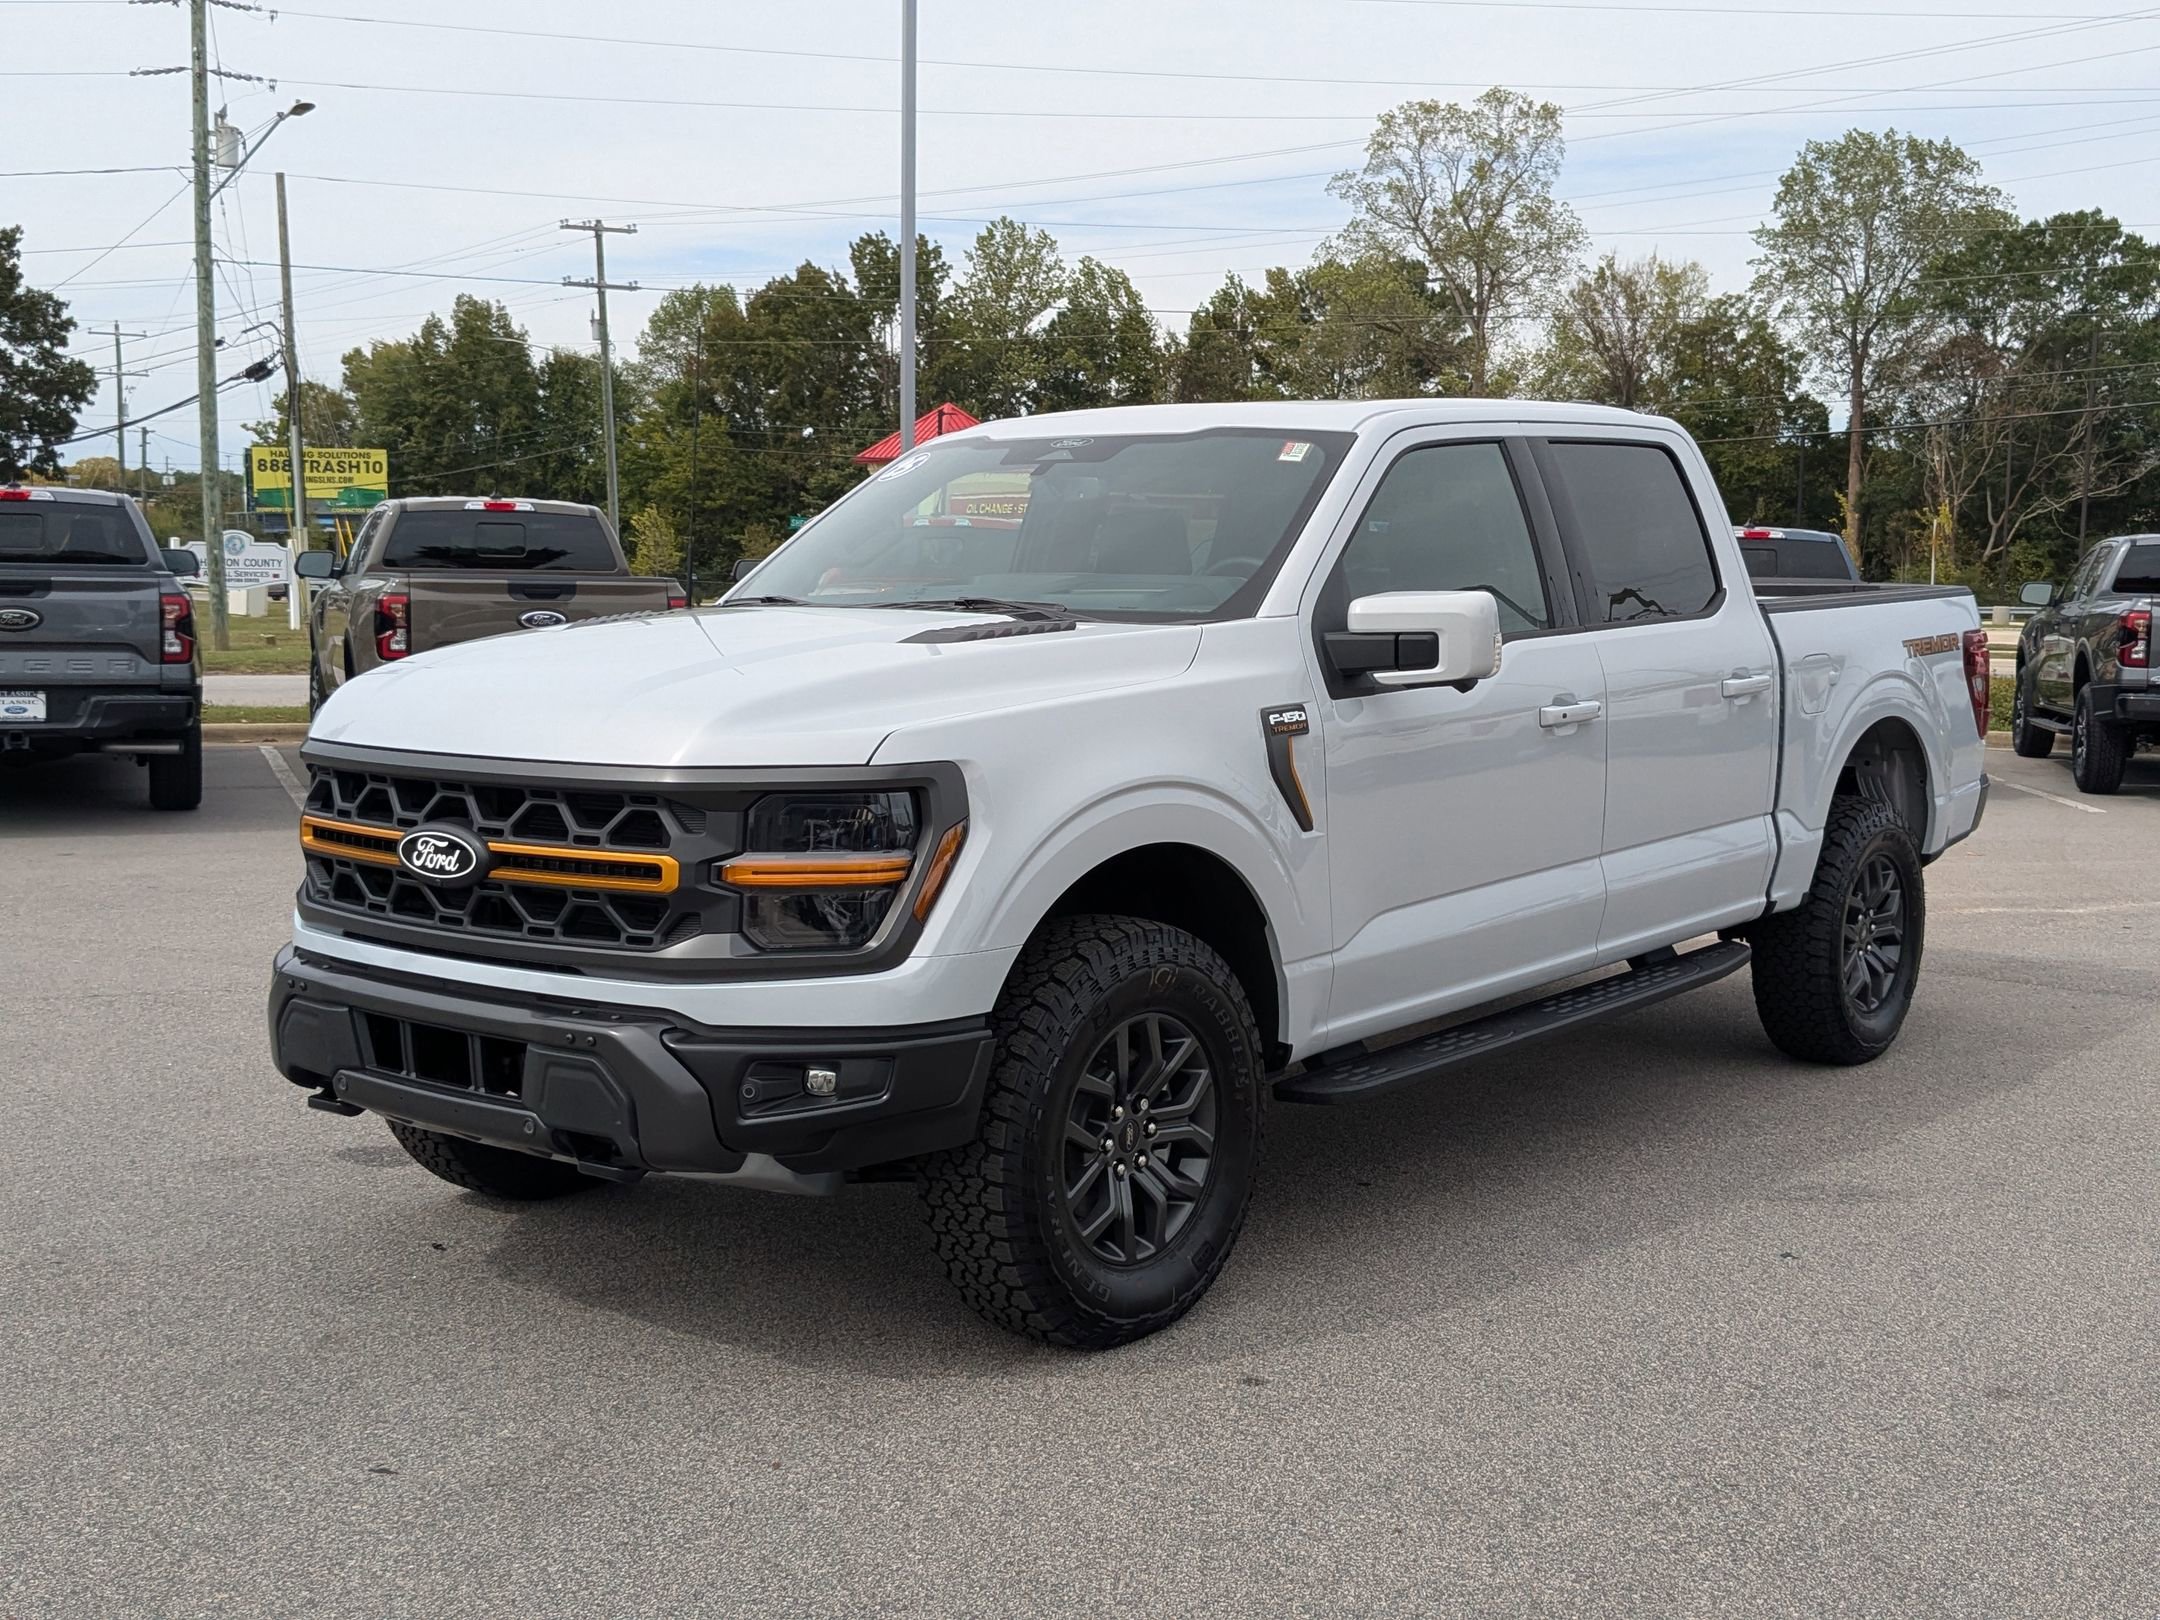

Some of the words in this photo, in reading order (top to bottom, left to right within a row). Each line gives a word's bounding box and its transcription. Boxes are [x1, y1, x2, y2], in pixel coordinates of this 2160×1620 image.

[979, 503, 1013, 514] CHANGE
[243, 558, 283, 568] COUNTY
[234, 570, 270, 578] SERVICES
[1902, 632, 1961, 658] TREMOR
[1269, 710, 1307, 725] F-150
[1272, 722, 1307, 733] TREMOR
[412, 836, 461, 872] Ford
